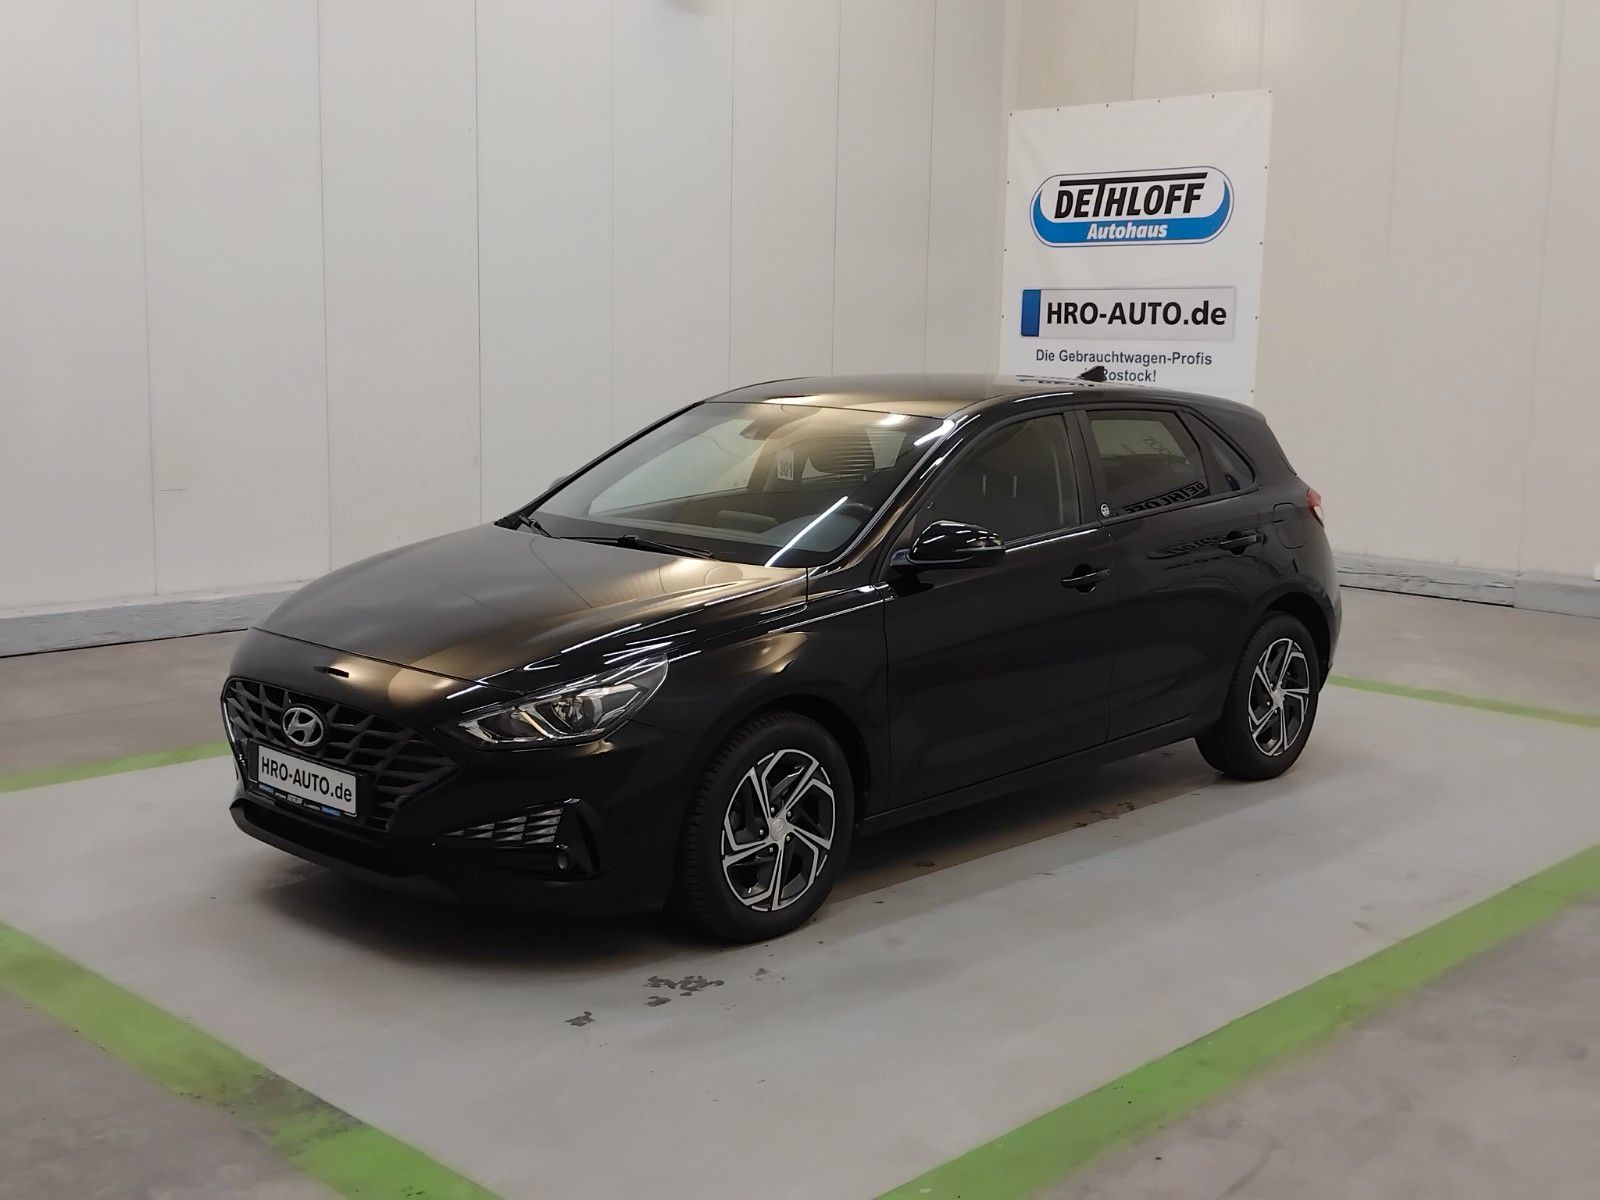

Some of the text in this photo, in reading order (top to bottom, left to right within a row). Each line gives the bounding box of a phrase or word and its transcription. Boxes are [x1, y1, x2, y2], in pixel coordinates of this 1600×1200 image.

[1054, 172, 1208, 218] DETHLOFF
[1086, 222, 1168, 240] Autohaus
[1046, 300, 1227, 325] HRO-AUTO.de
[1036, 349, 1212, 367] Die Gebrauchtwagen-Profis
[262, 757, 352, 802] HRO-AUTO.de
